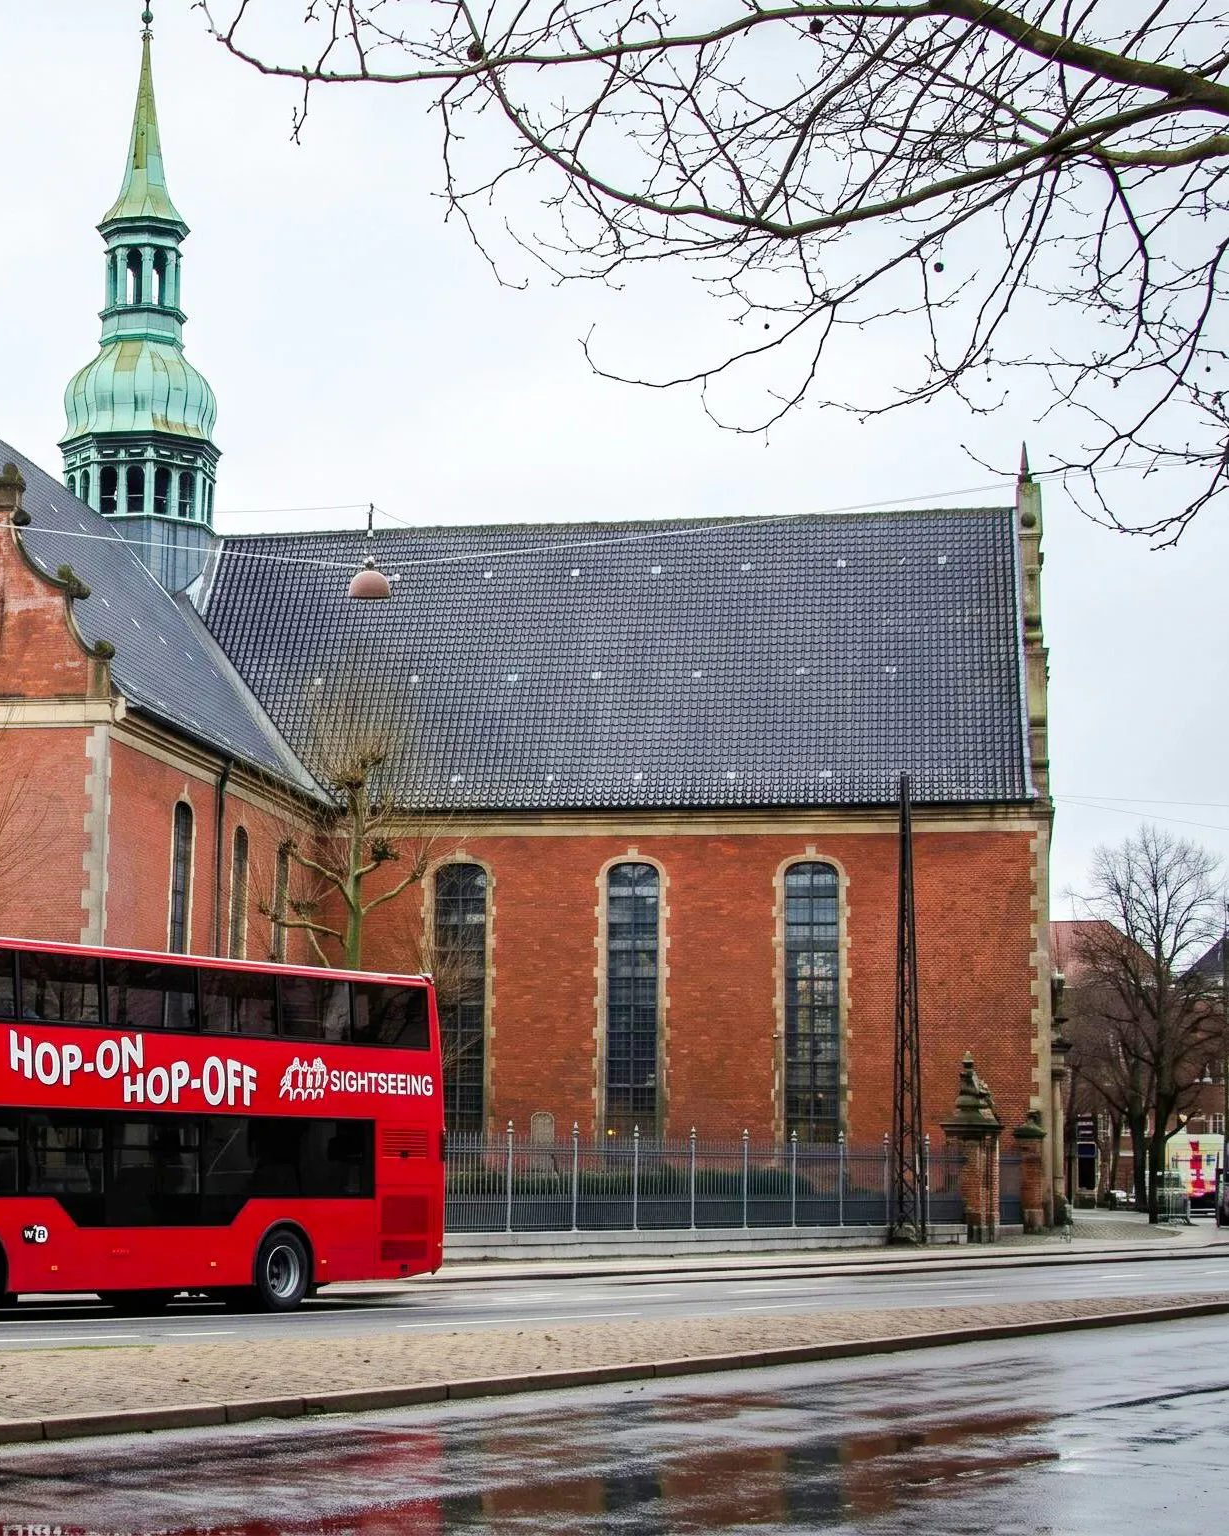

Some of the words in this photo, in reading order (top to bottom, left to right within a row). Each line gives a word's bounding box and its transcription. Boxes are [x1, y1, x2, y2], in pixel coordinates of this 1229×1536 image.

[9, 1029, 144, 1086] HOP-ON
[123, 1055, 258, 1106] HOP-OFF
[330, 1070, 434, 1096] SIGHTSEEING
